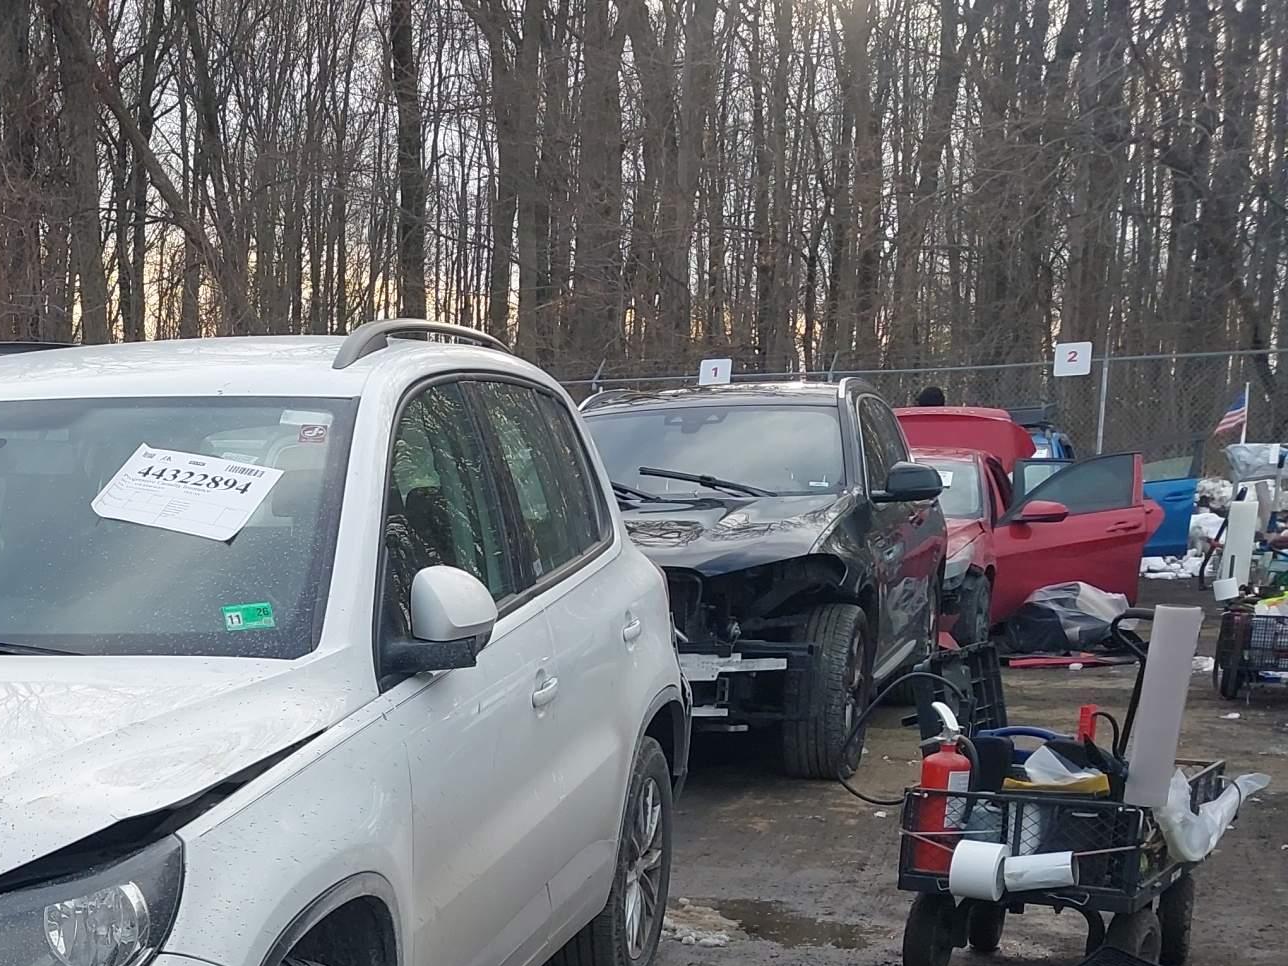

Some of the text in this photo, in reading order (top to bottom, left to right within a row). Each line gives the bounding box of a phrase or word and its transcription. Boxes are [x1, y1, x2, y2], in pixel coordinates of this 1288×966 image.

[1067, 350, 1078, 363] 2
[711, 367, 718, 377] 1
[137, 466, 252, 494] 44322894
[256, 607, 270, 617] 26
[227, 614, 242, 625] 11
